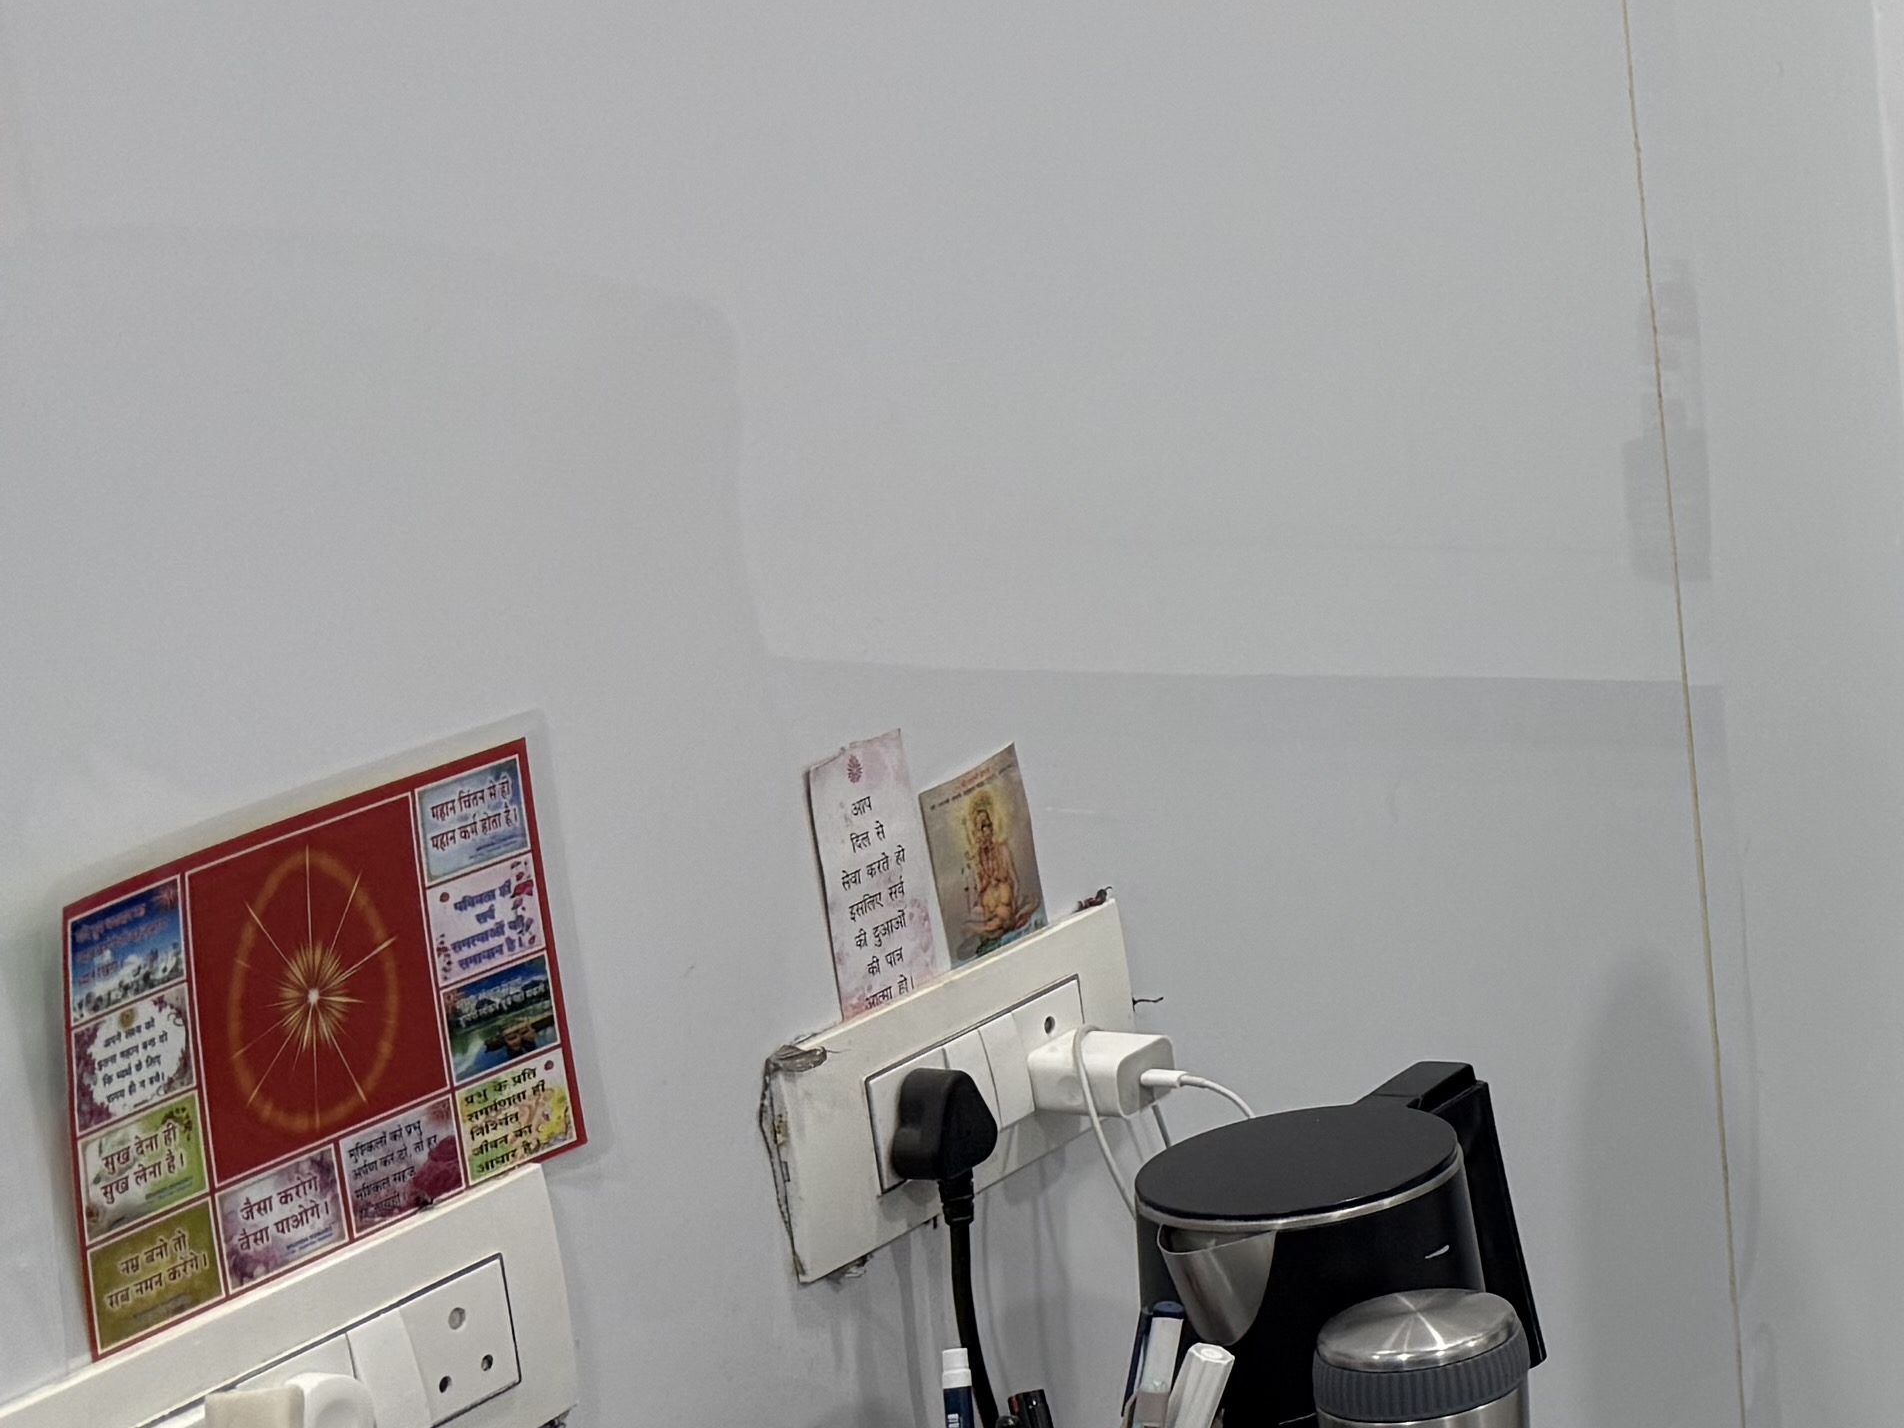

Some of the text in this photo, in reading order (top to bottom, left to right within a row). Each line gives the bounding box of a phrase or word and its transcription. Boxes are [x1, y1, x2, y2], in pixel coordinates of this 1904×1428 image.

[851, 796, 872, 816] आप
[479, 812, 502, 833] होता
[850, 820, 885, 853] दिल से
[841, 844, 906, 891] सेवा करते हो
[848, 875, 905, 922] इसलिए सर्व
[854, 928, 868, 949] की
[867, 946, 904, 976] की पात्र
[865, 985, 893, 1010] आत्मा
[102, 1122, 177, 1175] सुख देना ही
[100, 1175, 130, 1204] सुख
[133, 1163, 162, 1186] लेना
[240, 1173, 318, 1221] जैसा करोगे
[172, 1230, 187, 1252] तो
[238, 1227, 270, 1250] वैसा
[133, 1273, 163, 1295] नमन
